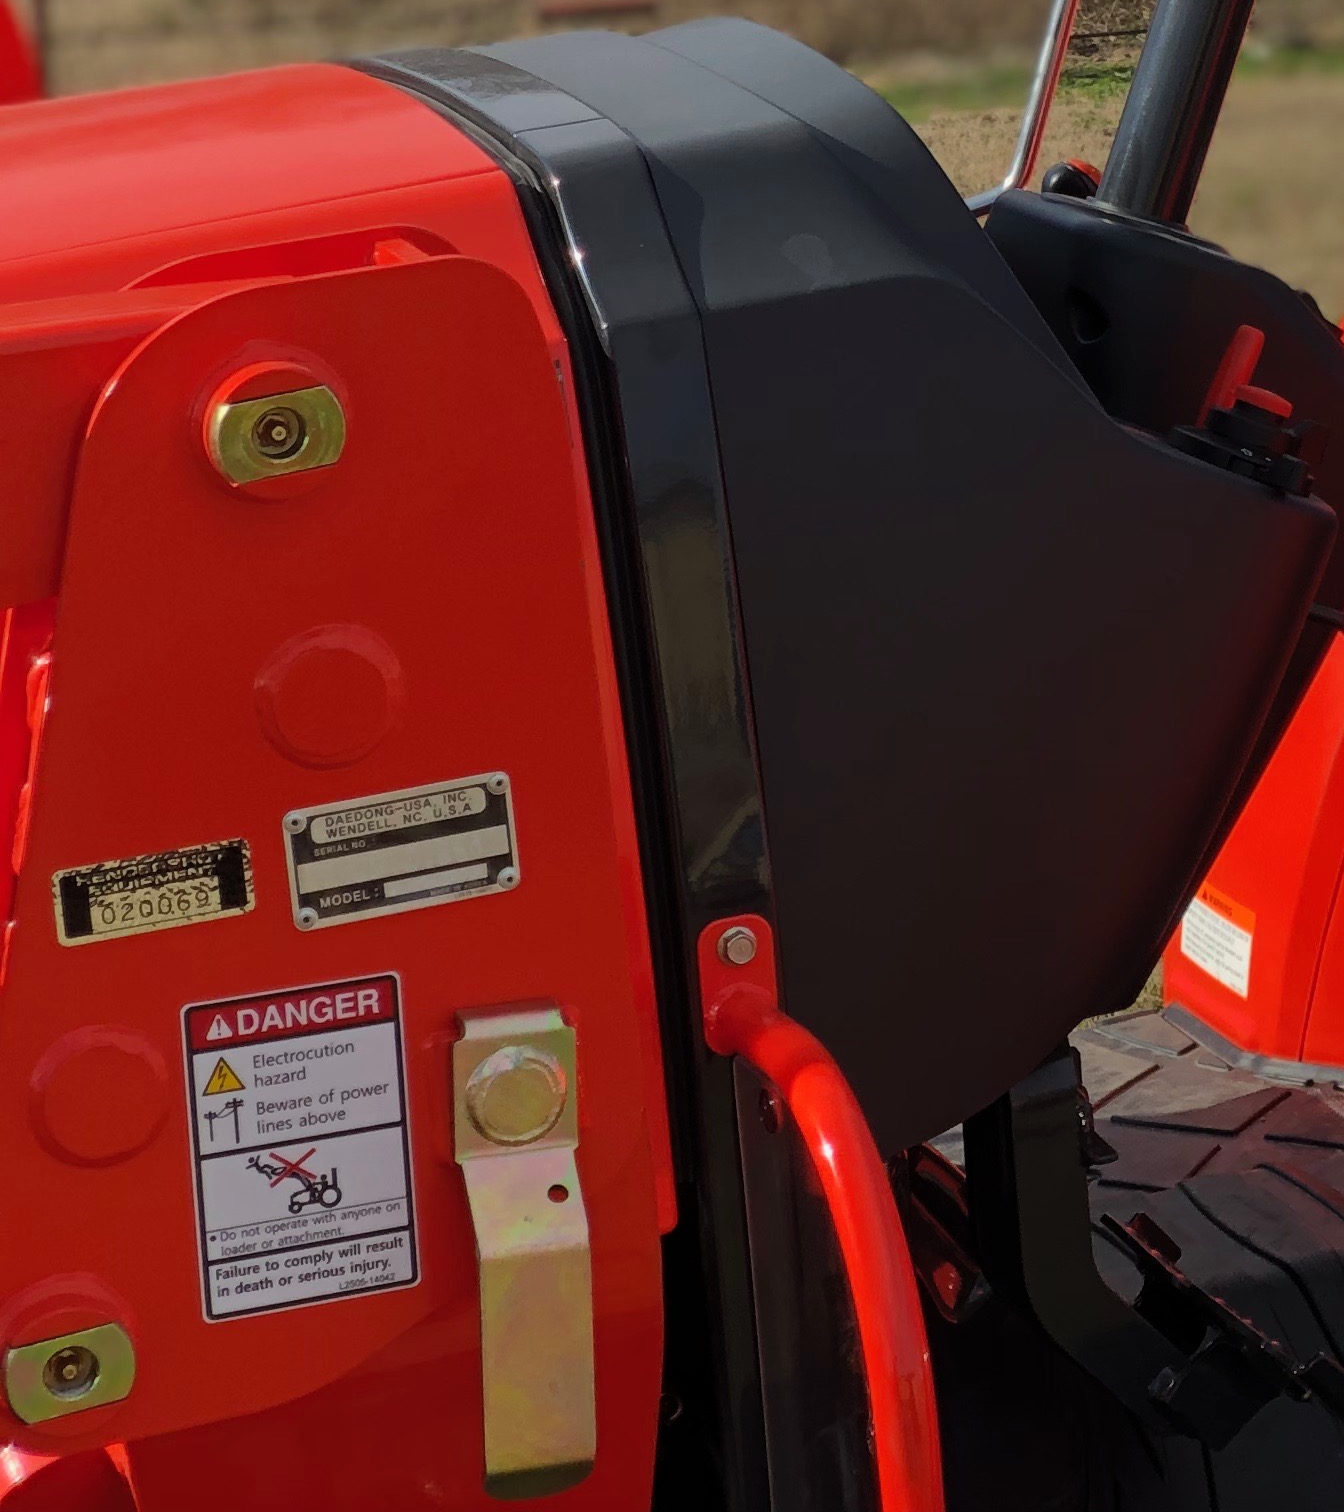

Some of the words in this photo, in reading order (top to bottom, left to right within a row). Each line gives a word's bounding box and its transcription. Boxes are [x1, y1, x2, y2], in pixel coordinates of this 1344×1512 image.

[442, 791, 472, 805] INC.
[313, 842, 349, 857] SERIAL
[236, 988, 380, 1036] DANGER
[253, 1042, 355, 1069] Electrocution
[254, 1066, 306, 1088] hazard
[256, 1096, 313, 1116] Beware
[318, 1089, 335, 1105] of
[340, 1082, 389, 1105] power
[257, 1118, 293, 1135] lines
[299, 1108, 346, 1128] above
[220, 1230, 236, 1243] Do
[241, 1226, 261, 1239] not
[264, 1218, 308, 1239] operate
[312, 1212, 337, 1226] with
[340, 1205, 382, 1224] anyone
[385, 1202, 400, 1213] on
[221, 1241, 257, 1257] loader
[261, 1238, 274, 1249] or
[277, 1226, 345, 1247] attachment.
[215, 1262, 260, 1281] Failure
[265, 1259, 280, 1272] to
[284, 1250, 334, 1268] comply
[338, 1244, 361, 1258] will
[366, 1237, 404, 1253] result
[217, 1284, 230, 1298] in
[235, 1276, 273, 1294] death
[278, 1275, 293, 1286] or
[298, 1266, 346, 1284] serious
[350, 1257, 392, 1278] injury.
